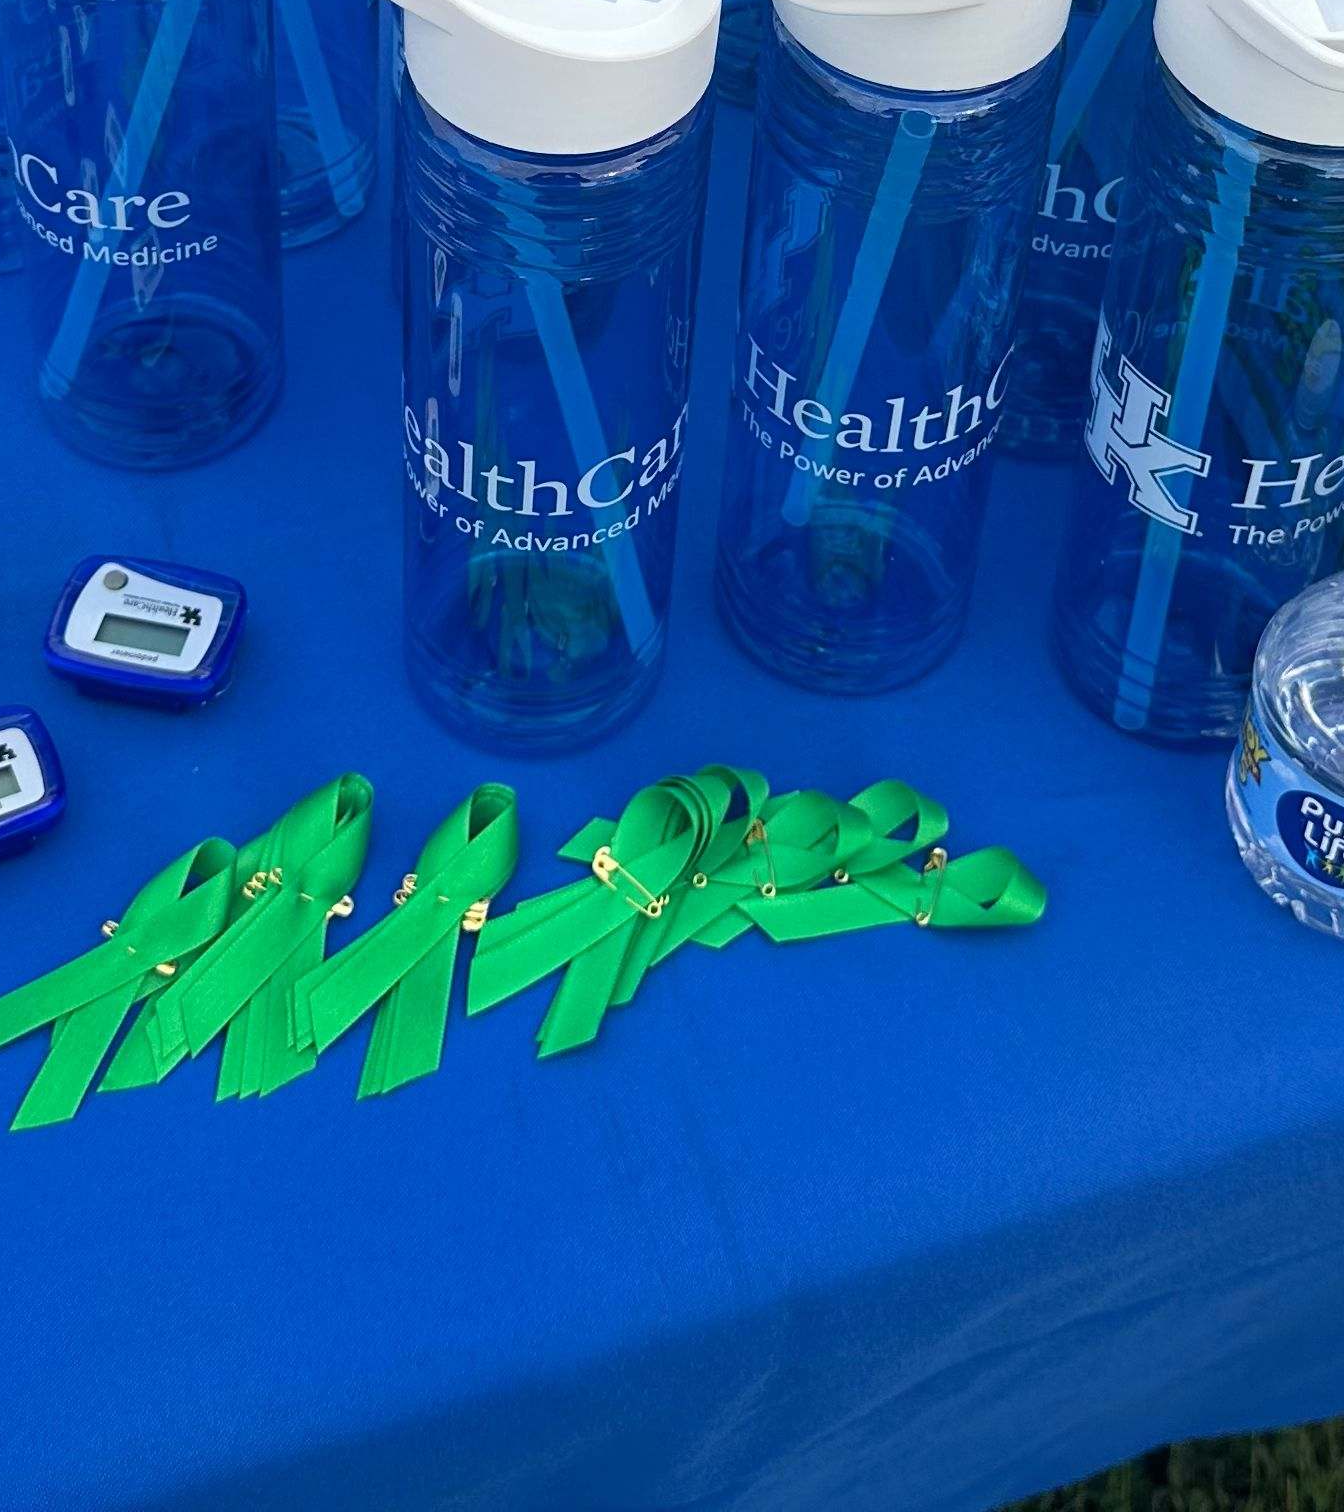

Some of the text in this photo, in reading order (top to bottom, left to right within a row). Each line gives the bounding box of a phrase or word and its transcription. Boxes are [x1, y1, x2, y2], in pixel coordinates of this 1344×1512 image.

[82, 234, 218, 266] Medicine
[779, 440, 866, 487] Power
[873, 467, 908, 489] of
[455, 515, 485, 539] of
[490, 506, 640, 553] Advanced
[1229, 524, 1285, 545] The
